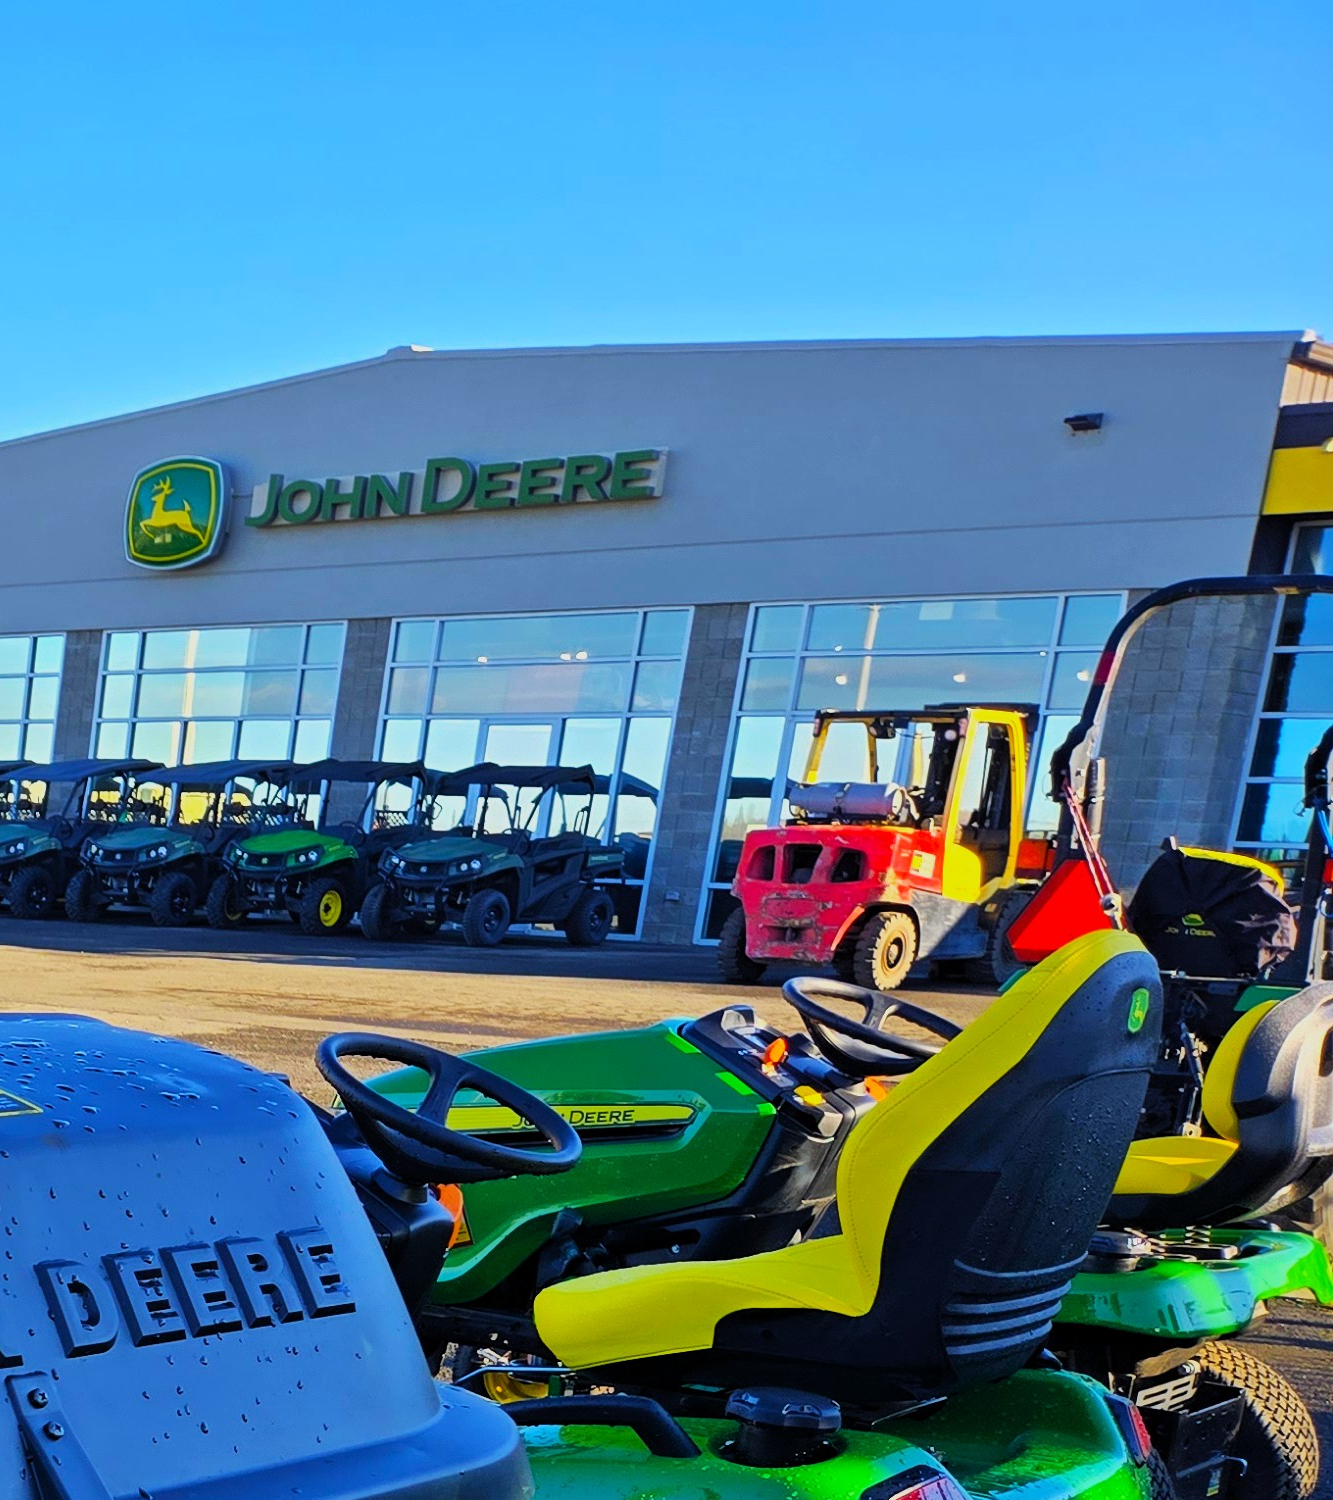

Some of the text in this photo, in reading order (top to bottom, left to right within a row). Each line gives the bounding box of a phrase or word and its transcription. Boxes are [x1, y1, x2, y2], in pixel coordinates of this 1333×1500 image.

[245, 449, 660, 527] JOHN DEERE
[569, 1109, 635, 1124] DEERE
[32, 1225, 357, 1360] DEERE
